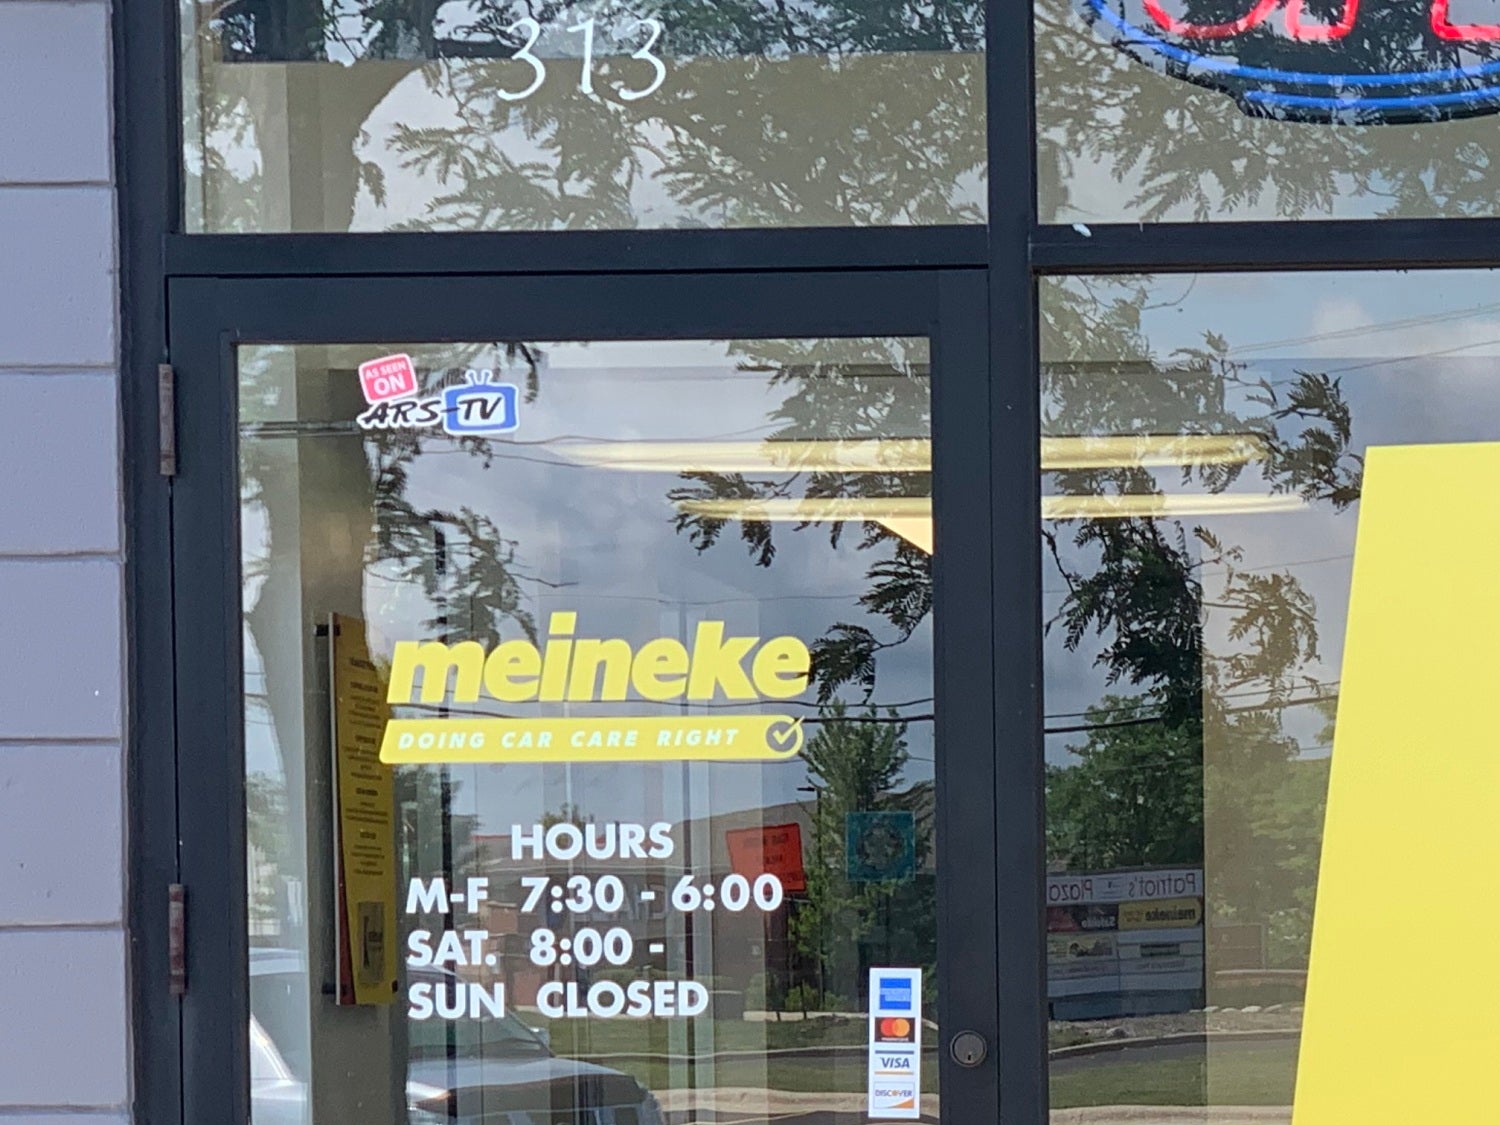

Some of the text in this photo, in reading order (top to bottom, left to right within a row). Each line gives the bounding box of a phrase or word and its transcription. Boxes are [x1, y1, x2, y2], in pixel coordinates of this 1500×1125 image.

[496, 17, 667, 101] 313
[365, 360, 407, 380] AS SEEN
[373, 373, 406, 395] ON
[386, 611, 812, 704] meineke
[398, 728, 740, 750] DOING CAR CARE RIGHT
[511, 822, 675, 860] HOURS
[405, 877, 489, 914] M-F
[520, 874, 624, 913] 7:30
[671, 873, 784, 912] 6:00
[406, 930, 497, 966] SAT.
[529, 927, 634, 966] 8:00
[407, 979, 709, 1019] SUN CLOSED
[880, 1056, 911, 1069] VISA
[875, 1089, 912, 1098] DISCOVER
